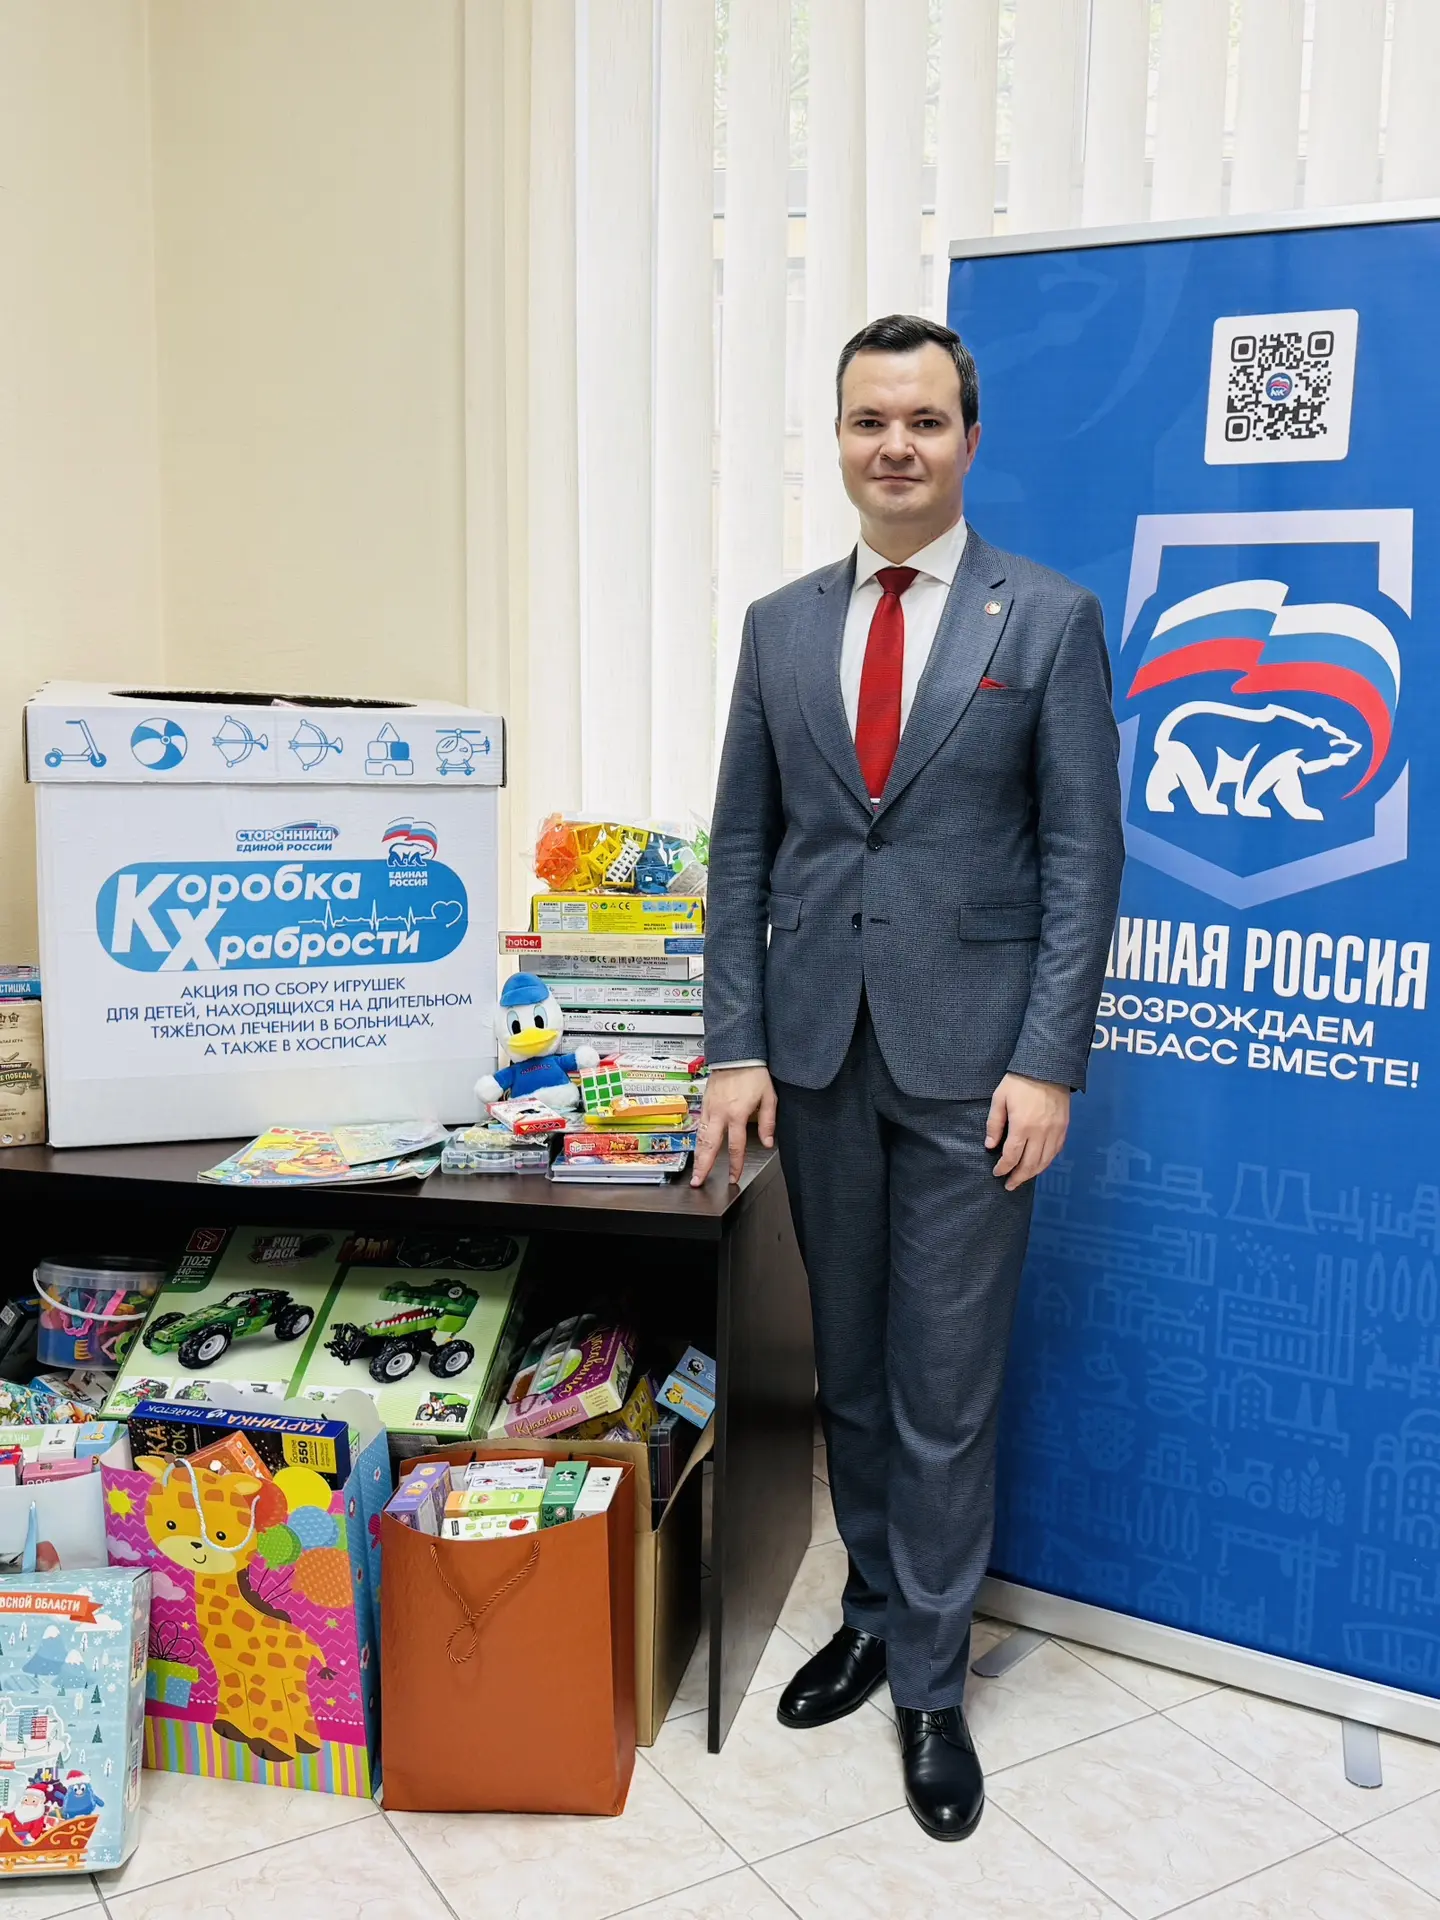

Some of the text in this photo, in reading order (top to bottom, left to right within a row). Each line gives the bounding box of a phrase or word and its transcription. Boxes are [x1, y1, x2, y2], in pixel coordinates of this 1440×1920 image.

[235, 829, 333, 841] СТОРОННИКИ
[236, 842, 333, 853] ЕДИНОЙ РОССИИ
[388, 871, 428, 880] ЕДИНАЯ
[388, 878, 428, 887] РОССИЯ
[111, 864, 363, 952] Коробка
[160, 907, 421, 972] Храбрости
[508, 938, 539, 947] hatber
[1105, 917, 1431, 1010] ИНАЯ РОССИЯ
[180, 977, 406, 999] АКЦИЯ ПО СБОРУ ИГРУШЕК
[106, 992, 473, 1023] ДЛЯ ДЕТЕЙ, НАХОДЯЩИХСЯ НА ДЛИТЕЛЬНОМ
[150, 1013, 435, 1038] ТЯЖЁЛОМ ЛЕЧЕНИИ В БОЛЬНИЦАХ,
[1097, 992, 1375, 1047] ВОЗРОЖДАЕМ
[204, 1033, 387, 1056] А ТАКЖЕ В ХОСПИСАХ
[1247, 1042, 1420, 1089] ВМЕСТЕ!
[662, 1084, 681, 1093] CLAY
[272, 1236, 301, 1248] PULL
[262, 1247, 300, 1260] BACK
[145, 1404, 205, 1419] ПАЙЕТОК
[228, 1414, 327, 1434] КАРТИНКА
[298, 1440, 309, 1465] 550
[35, 1597, 81, 1612] ОБЛАСТИ
